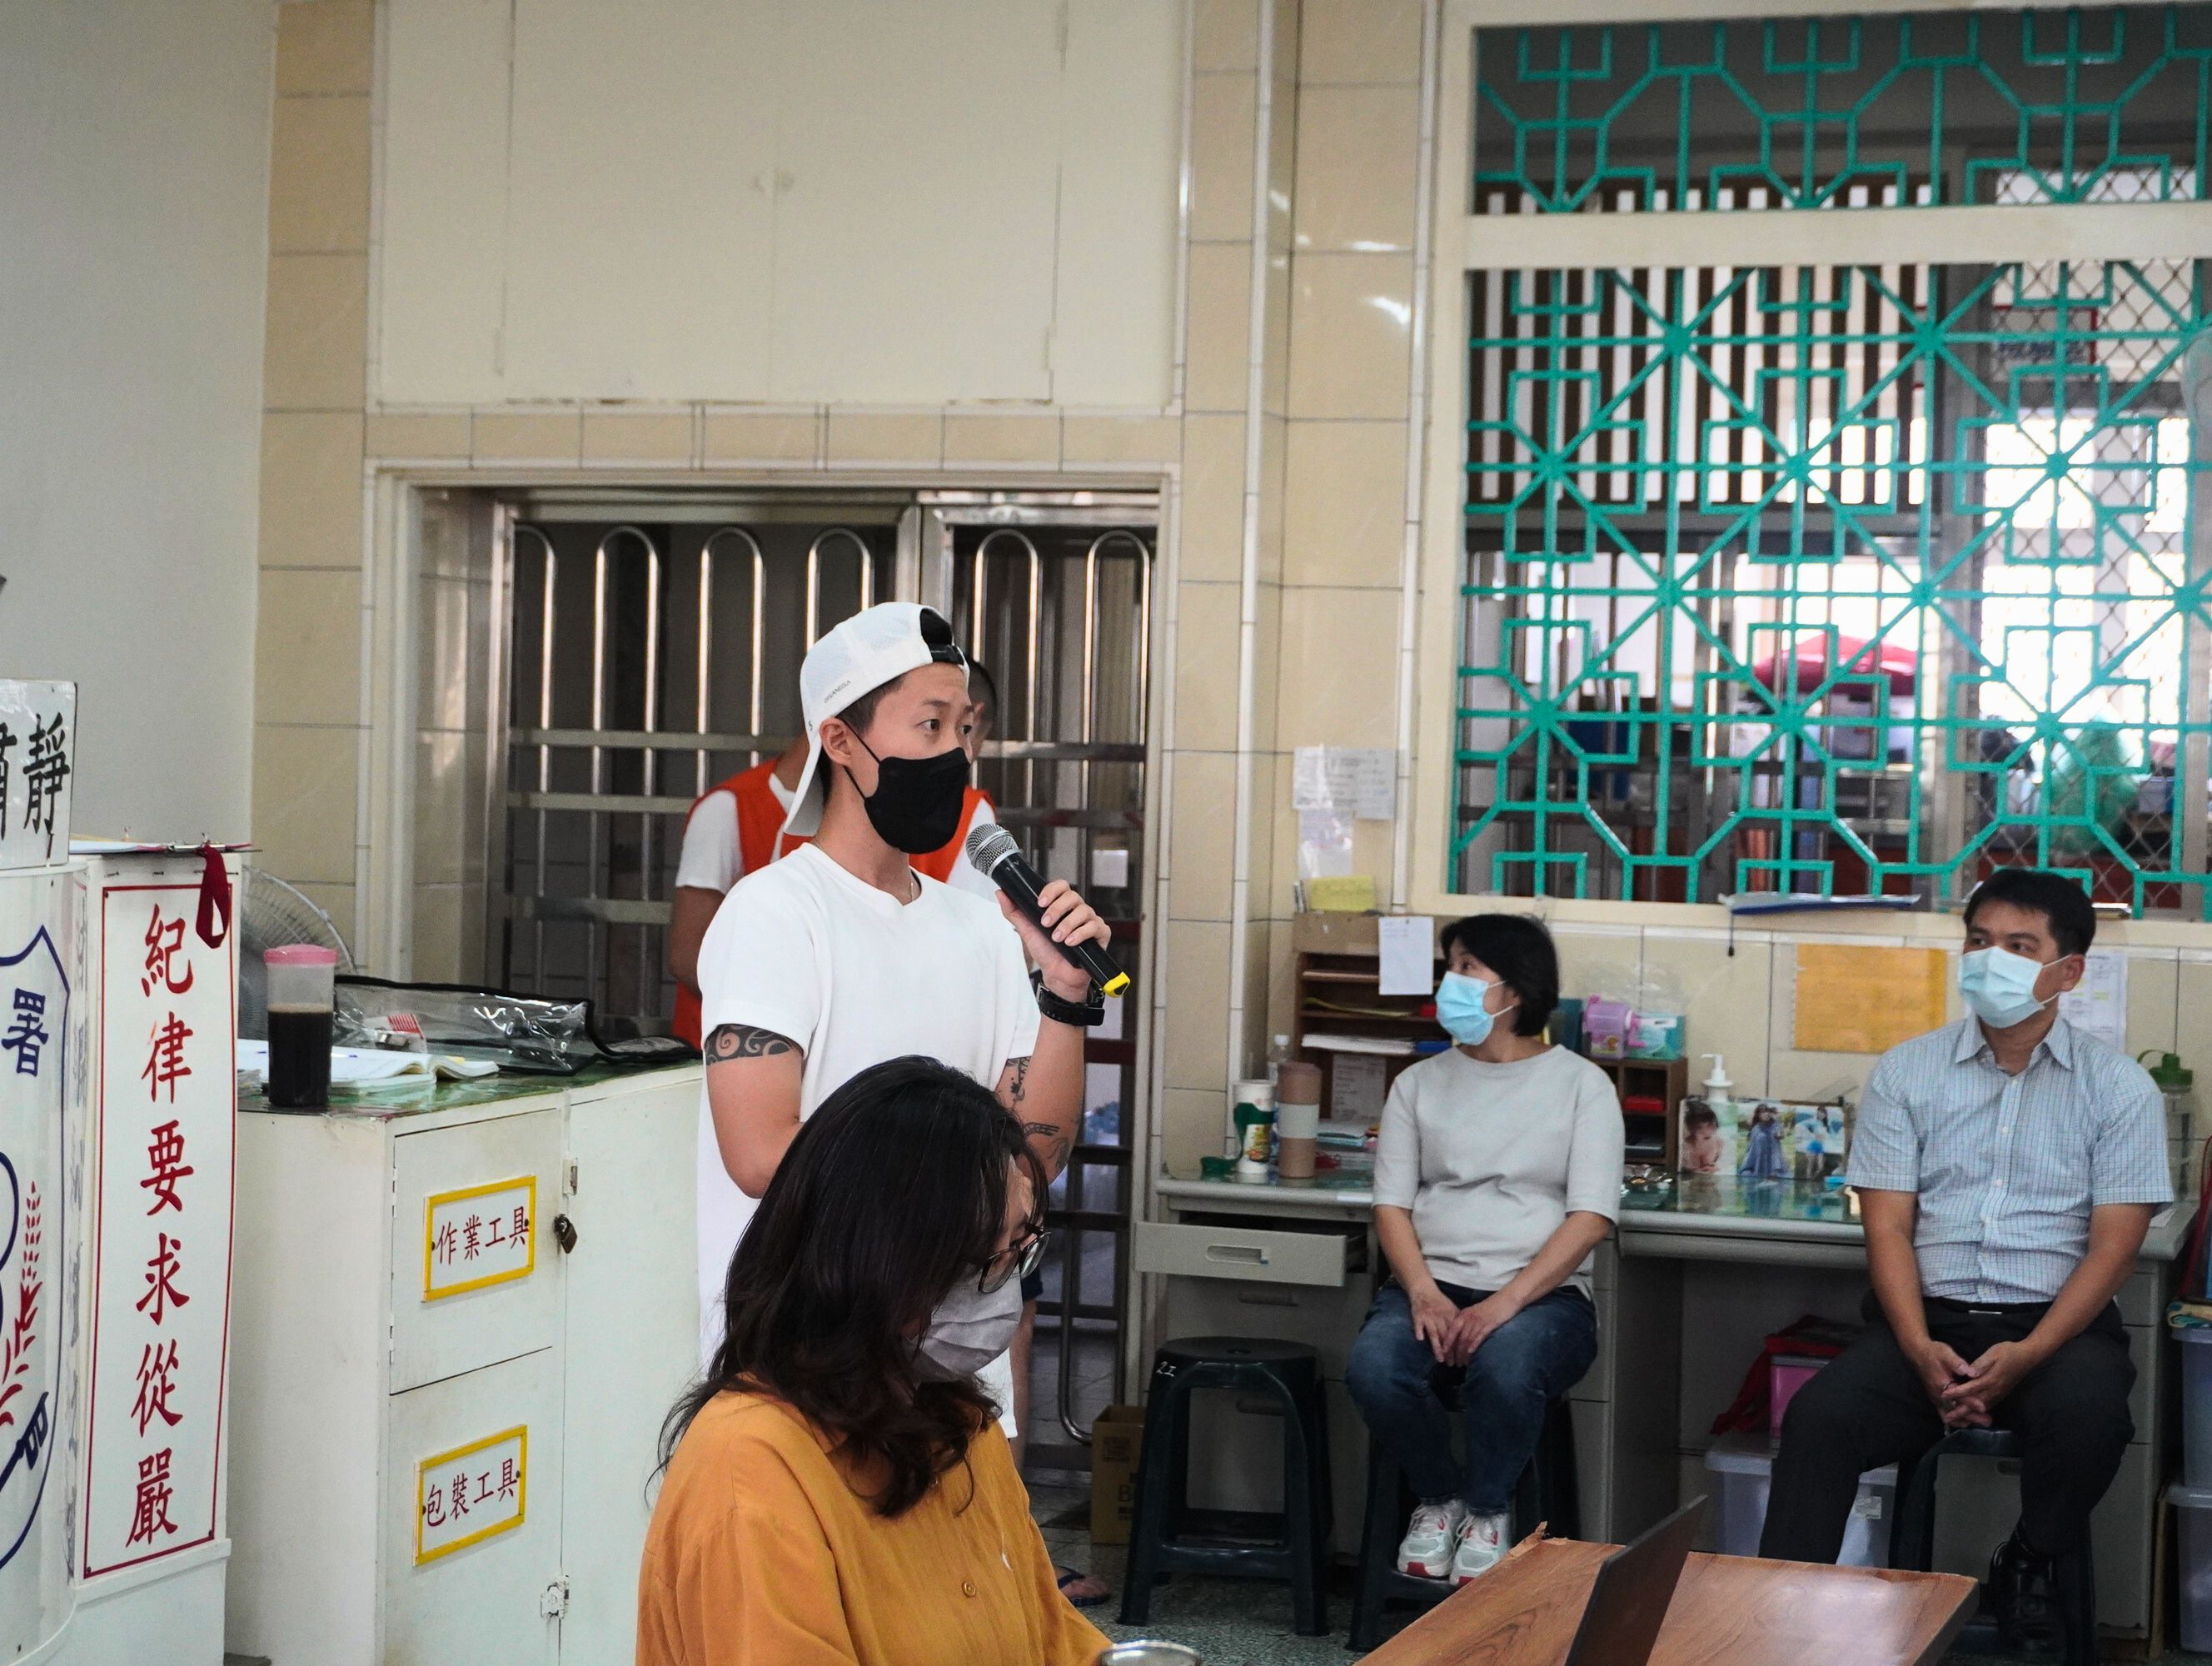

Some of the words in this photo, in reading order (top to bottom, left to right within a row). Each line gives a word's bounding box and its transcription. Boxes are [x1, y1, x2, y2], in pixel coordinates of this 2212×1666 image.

[2, 988, 49, 1076] 署
[125, 903, 194, 1549] 紀律要求從嚴
[434, 1205, 530, 1266] 作業工具
[425, 1457, 518, 1528] 包裝工具
